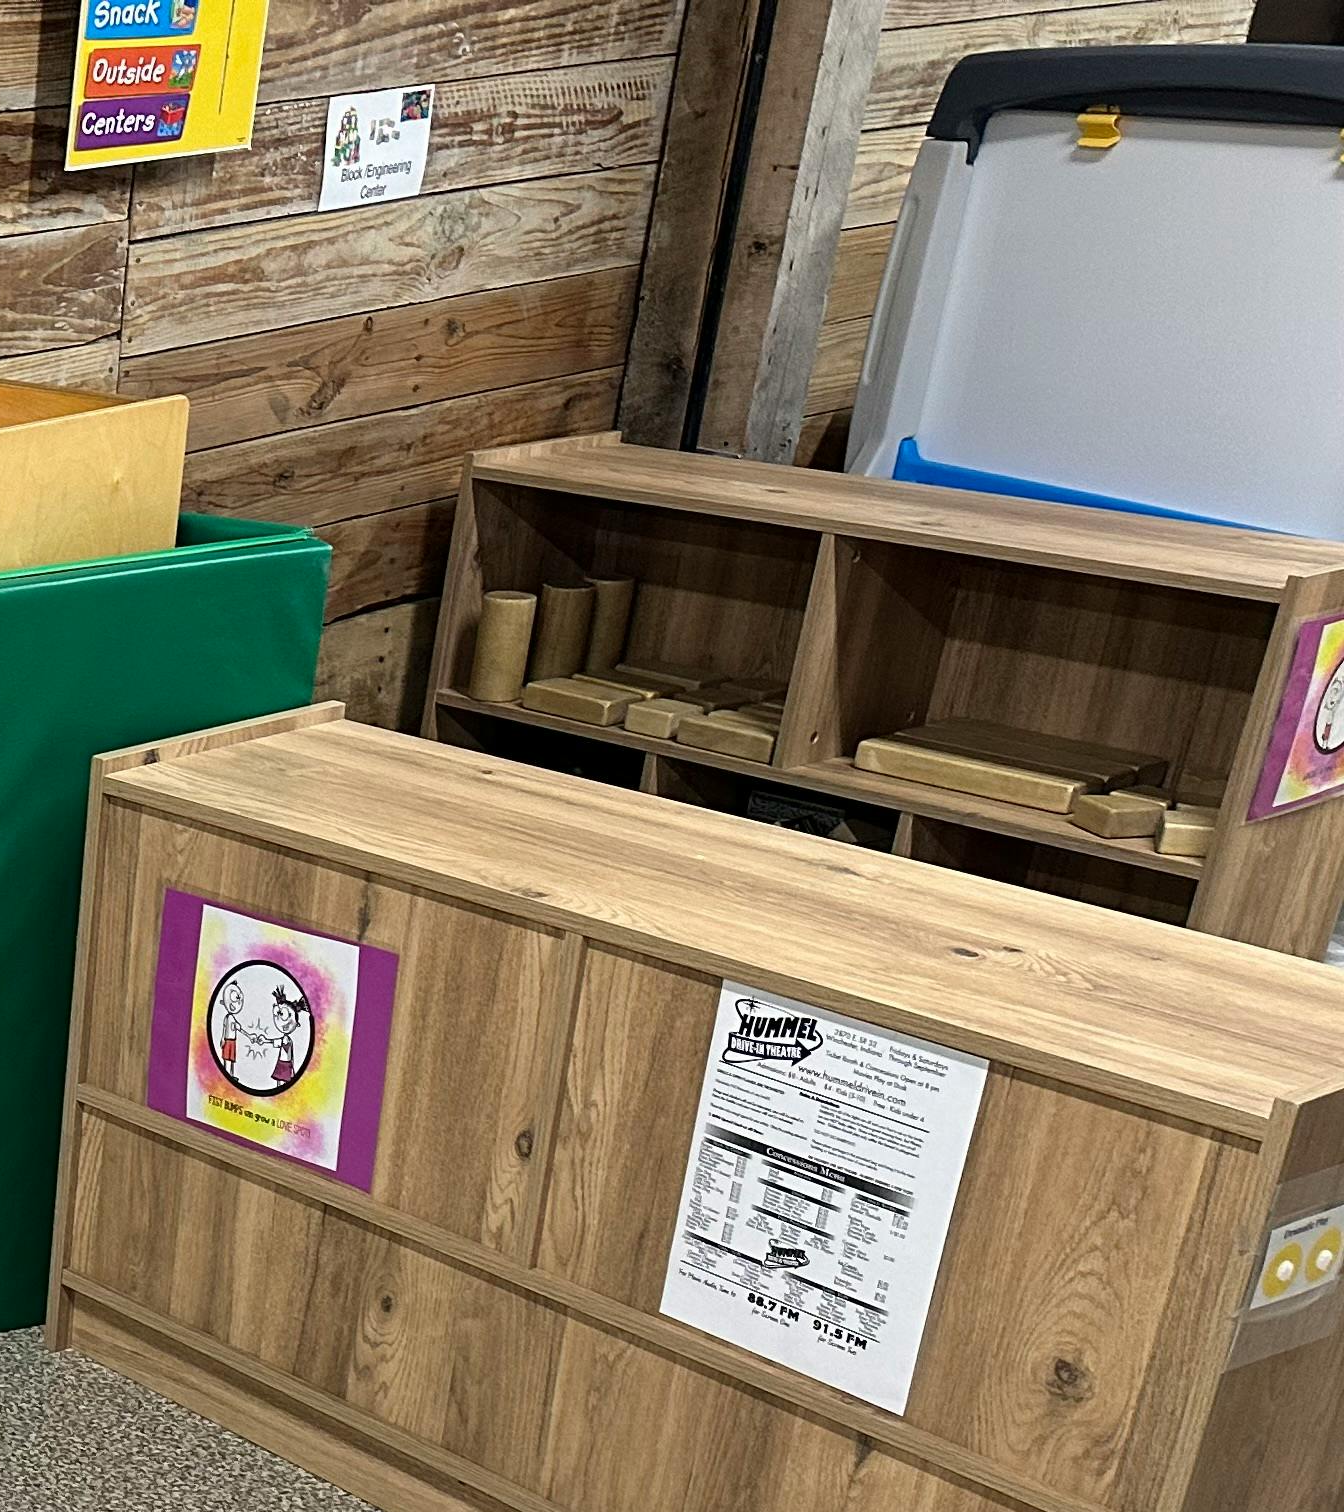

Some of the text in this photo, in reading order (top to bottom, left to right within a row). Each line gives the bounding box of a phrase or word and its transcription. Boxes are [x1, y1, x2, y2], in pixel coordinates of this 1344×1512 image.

[94, 0, 160, 28] Snack
[91, 56, 166, 86] Outside
[81, 100, 156, 137] Centers
[341, 168, 363, 183] Block
[359, 184, 388, 200] Center
[738, 1013, 819, 1043] HUMMEL
[729, 1035, 803, 1060] DRIVE-IN THEATRE
[797, 1062, 907, 1108] www.hummeldrivein.com
[898, 1074, 916, 1087] Open
[765, 1146, 846, 1183] Concessions Menu
[746, 1291, 799, 1322] 88.7 FM
[812, 1319, 867, 1350] 91.5 FM
